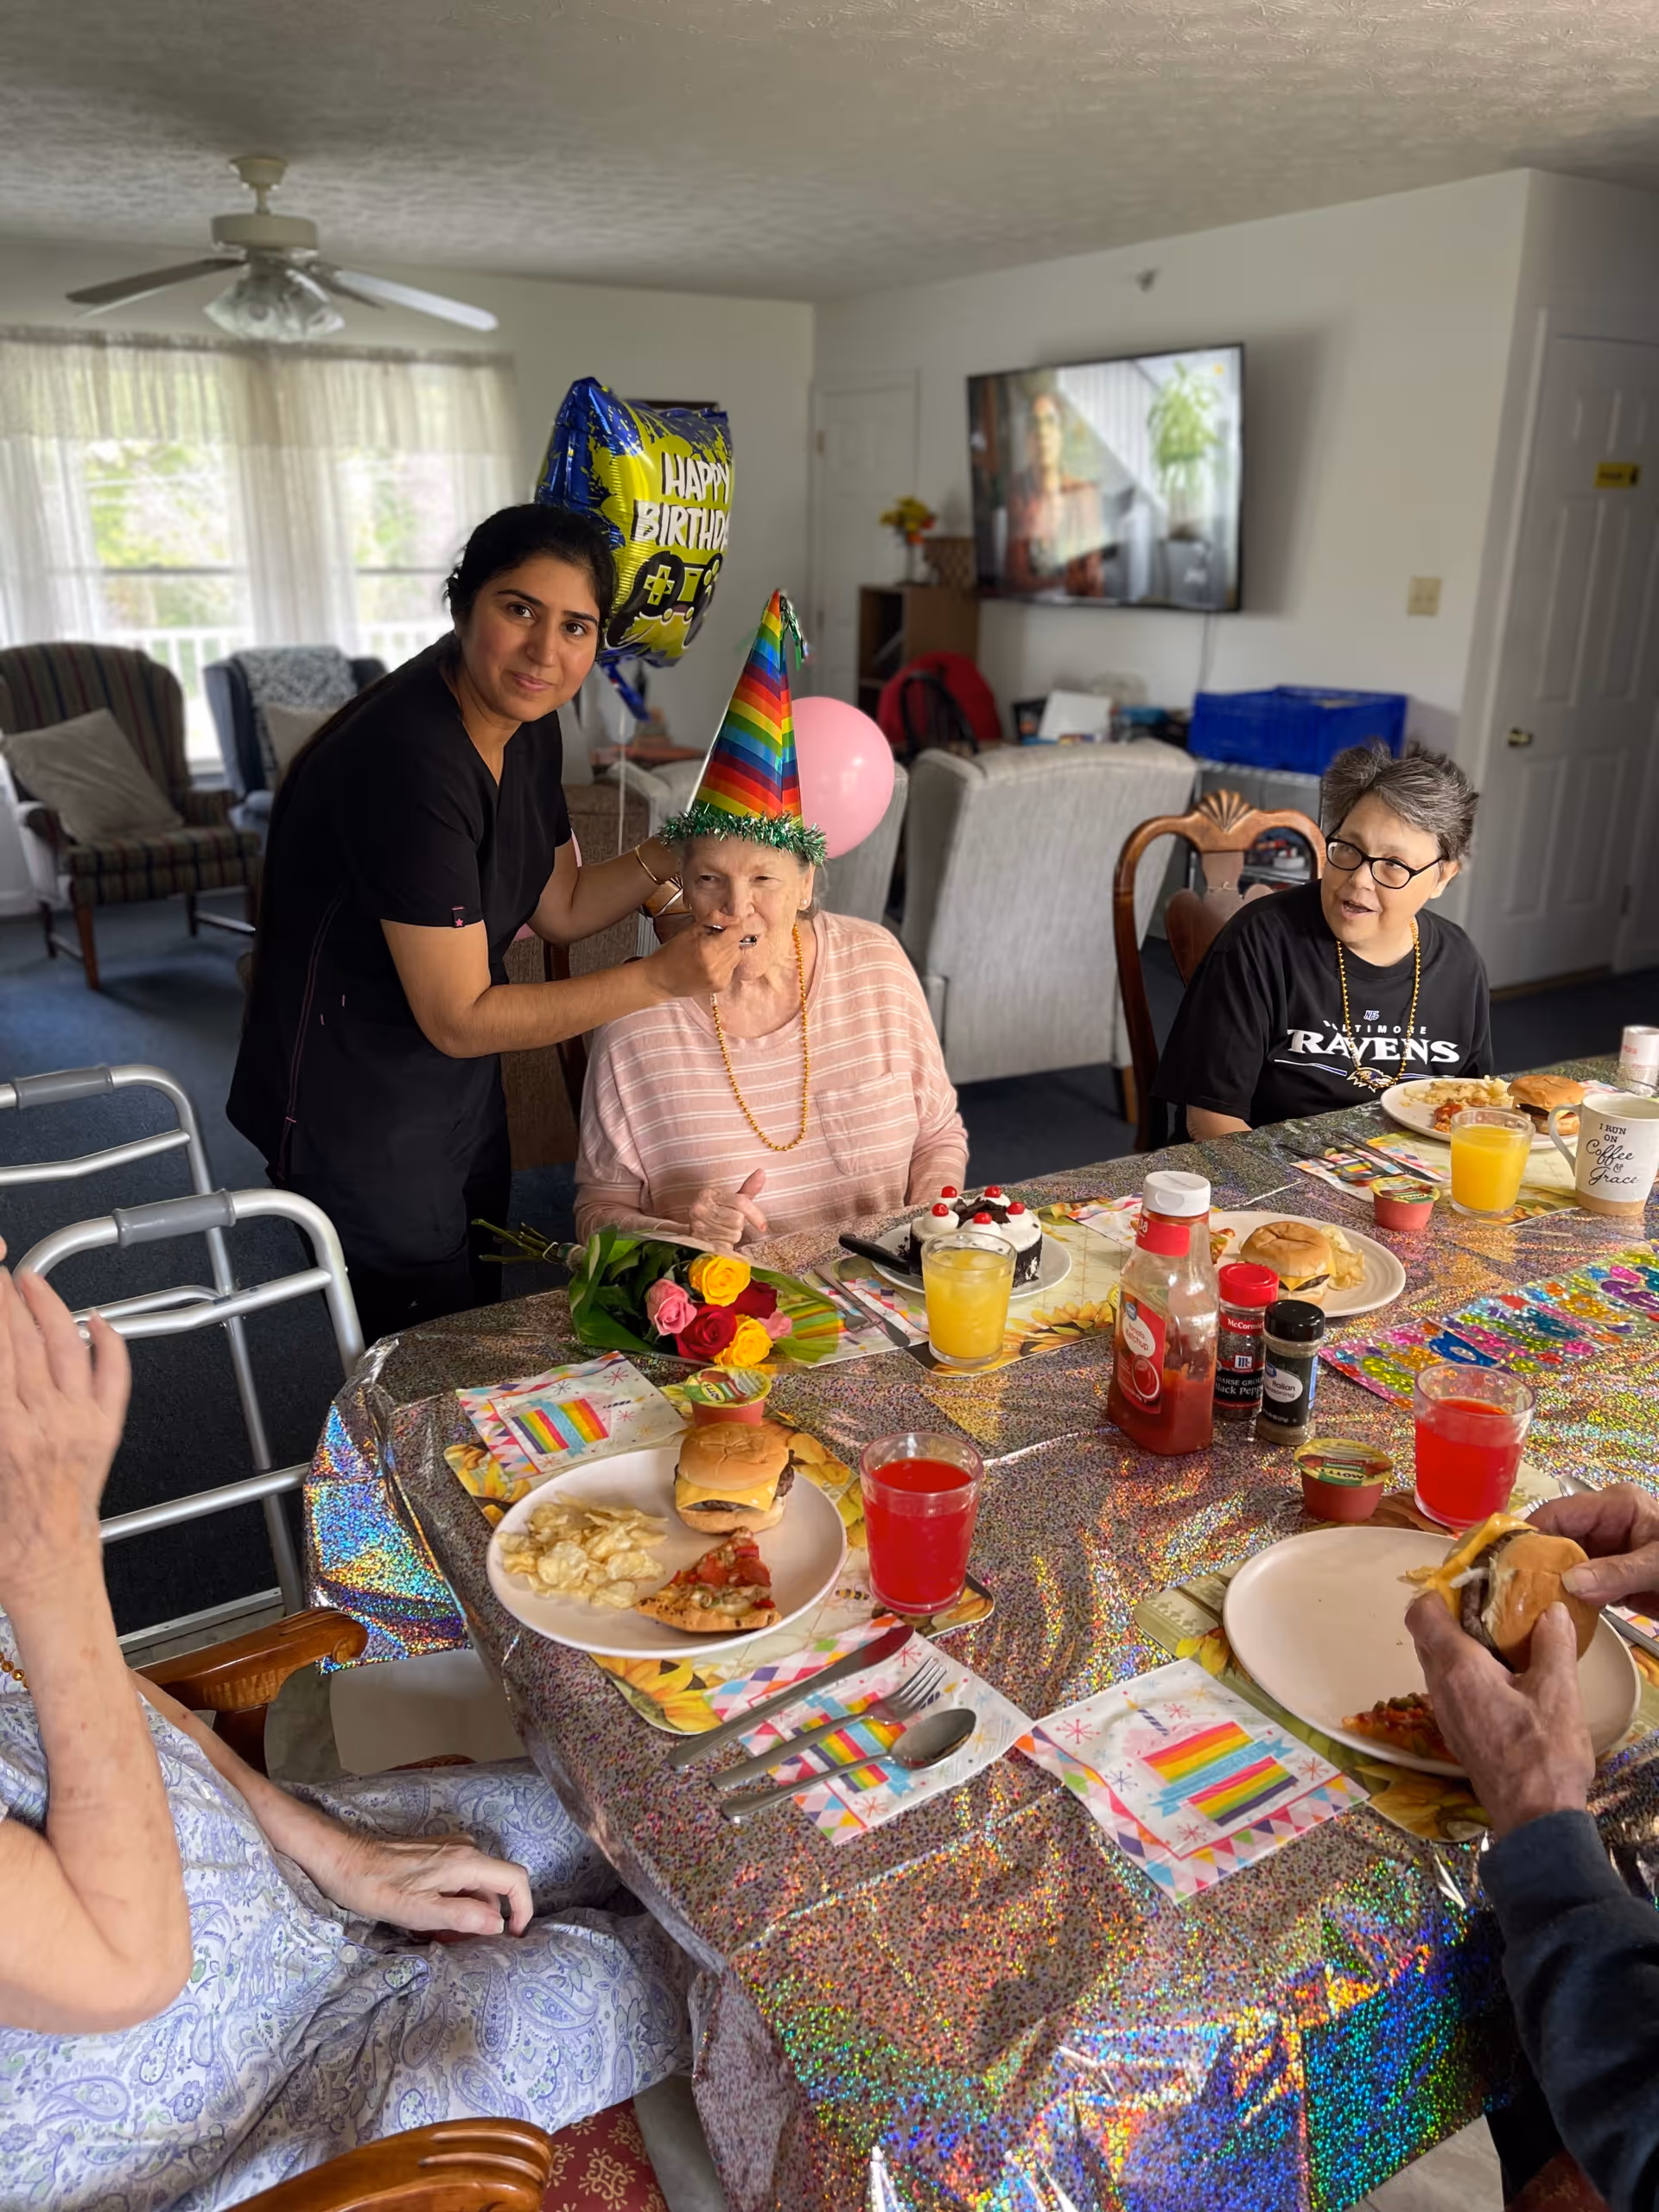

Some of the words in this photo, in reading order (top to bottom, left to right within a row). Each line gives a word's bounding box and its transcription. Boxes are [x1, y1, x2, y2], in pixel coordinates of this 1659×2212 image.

[662, 452, 729, 505] HAPPY
[632, 499, 730, 552] BIRTHDA
[1287, 1028, 1460, 1065] RAVENS
[1604, 1134, 1618, 1143] ON
[1605, 1124, 1627, 1135] RUN
[1586, 1139, 1635, 1166] Coffee
[1588, 1166, 1640, 1185] Grace
[1227, 1318, 1264, 1330] McCormic
[1216, 1375, 1240, 1386] OARSE
